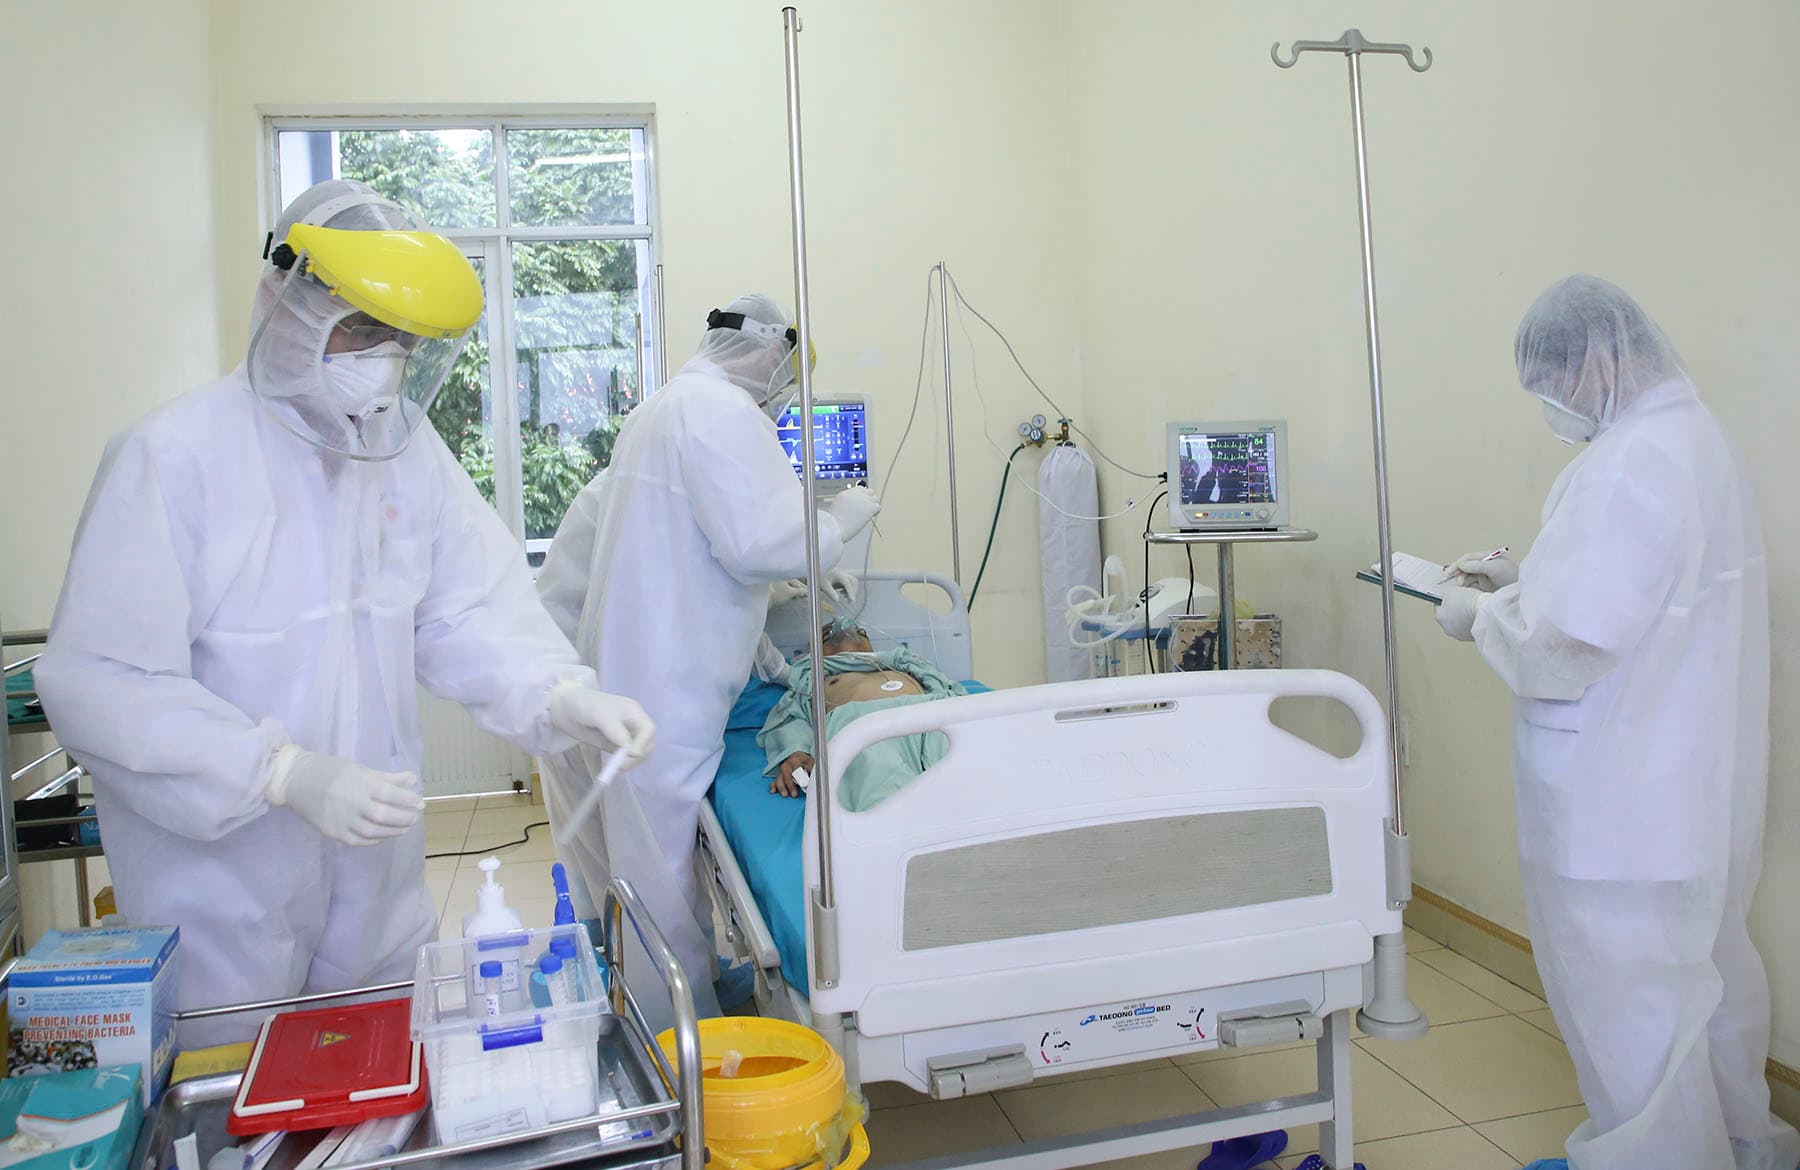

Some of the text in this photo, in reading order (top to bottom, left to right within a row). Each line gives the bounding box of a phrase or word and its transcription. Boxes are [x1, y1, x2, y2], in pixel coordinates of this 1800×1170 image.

[1254, 438, 1264, 446] 84
[29, 1012, 132, 1027] MEDICAL FACE MASK
[1099, 1011, 1133, 1021] TAEDONG
[1156, 1004, 1171, 1013] BED
[23, 1025, 136, 1041] PREVENTING BACTERIA
